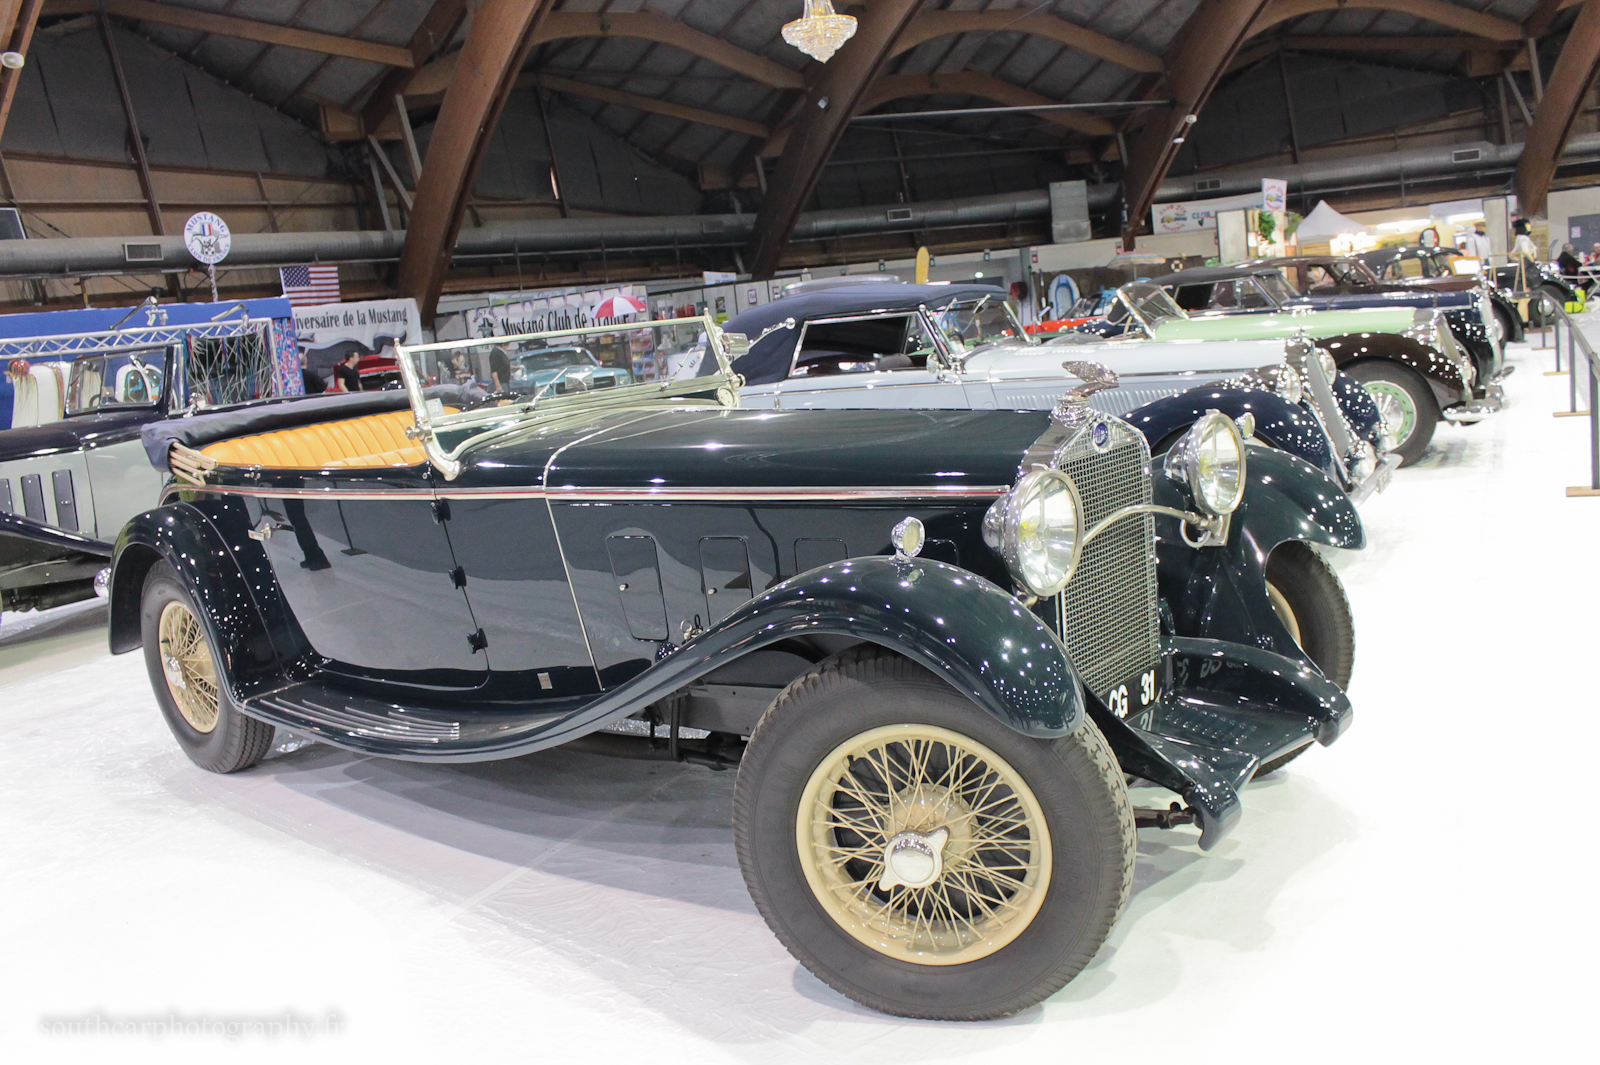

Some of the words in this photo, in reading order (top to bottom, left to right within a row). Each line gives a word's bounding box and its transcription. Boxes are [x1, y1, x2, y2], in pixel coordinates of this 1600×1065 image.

[186, 213, 226, 232] MUSTANG
[293, 311, 340, 330] iversaire
[343, 310, 355, 326] de
[356, 309, 366, 325] la
[368, 307, 408, 325] Mustang
[501, 313, 544, 336] Mustang
[547, 309, 572, 332] Club
[574, 307, 587, 328] de
[1108, 684, 1129, 719] CG
[1140, 669, 1155, 706] 31
